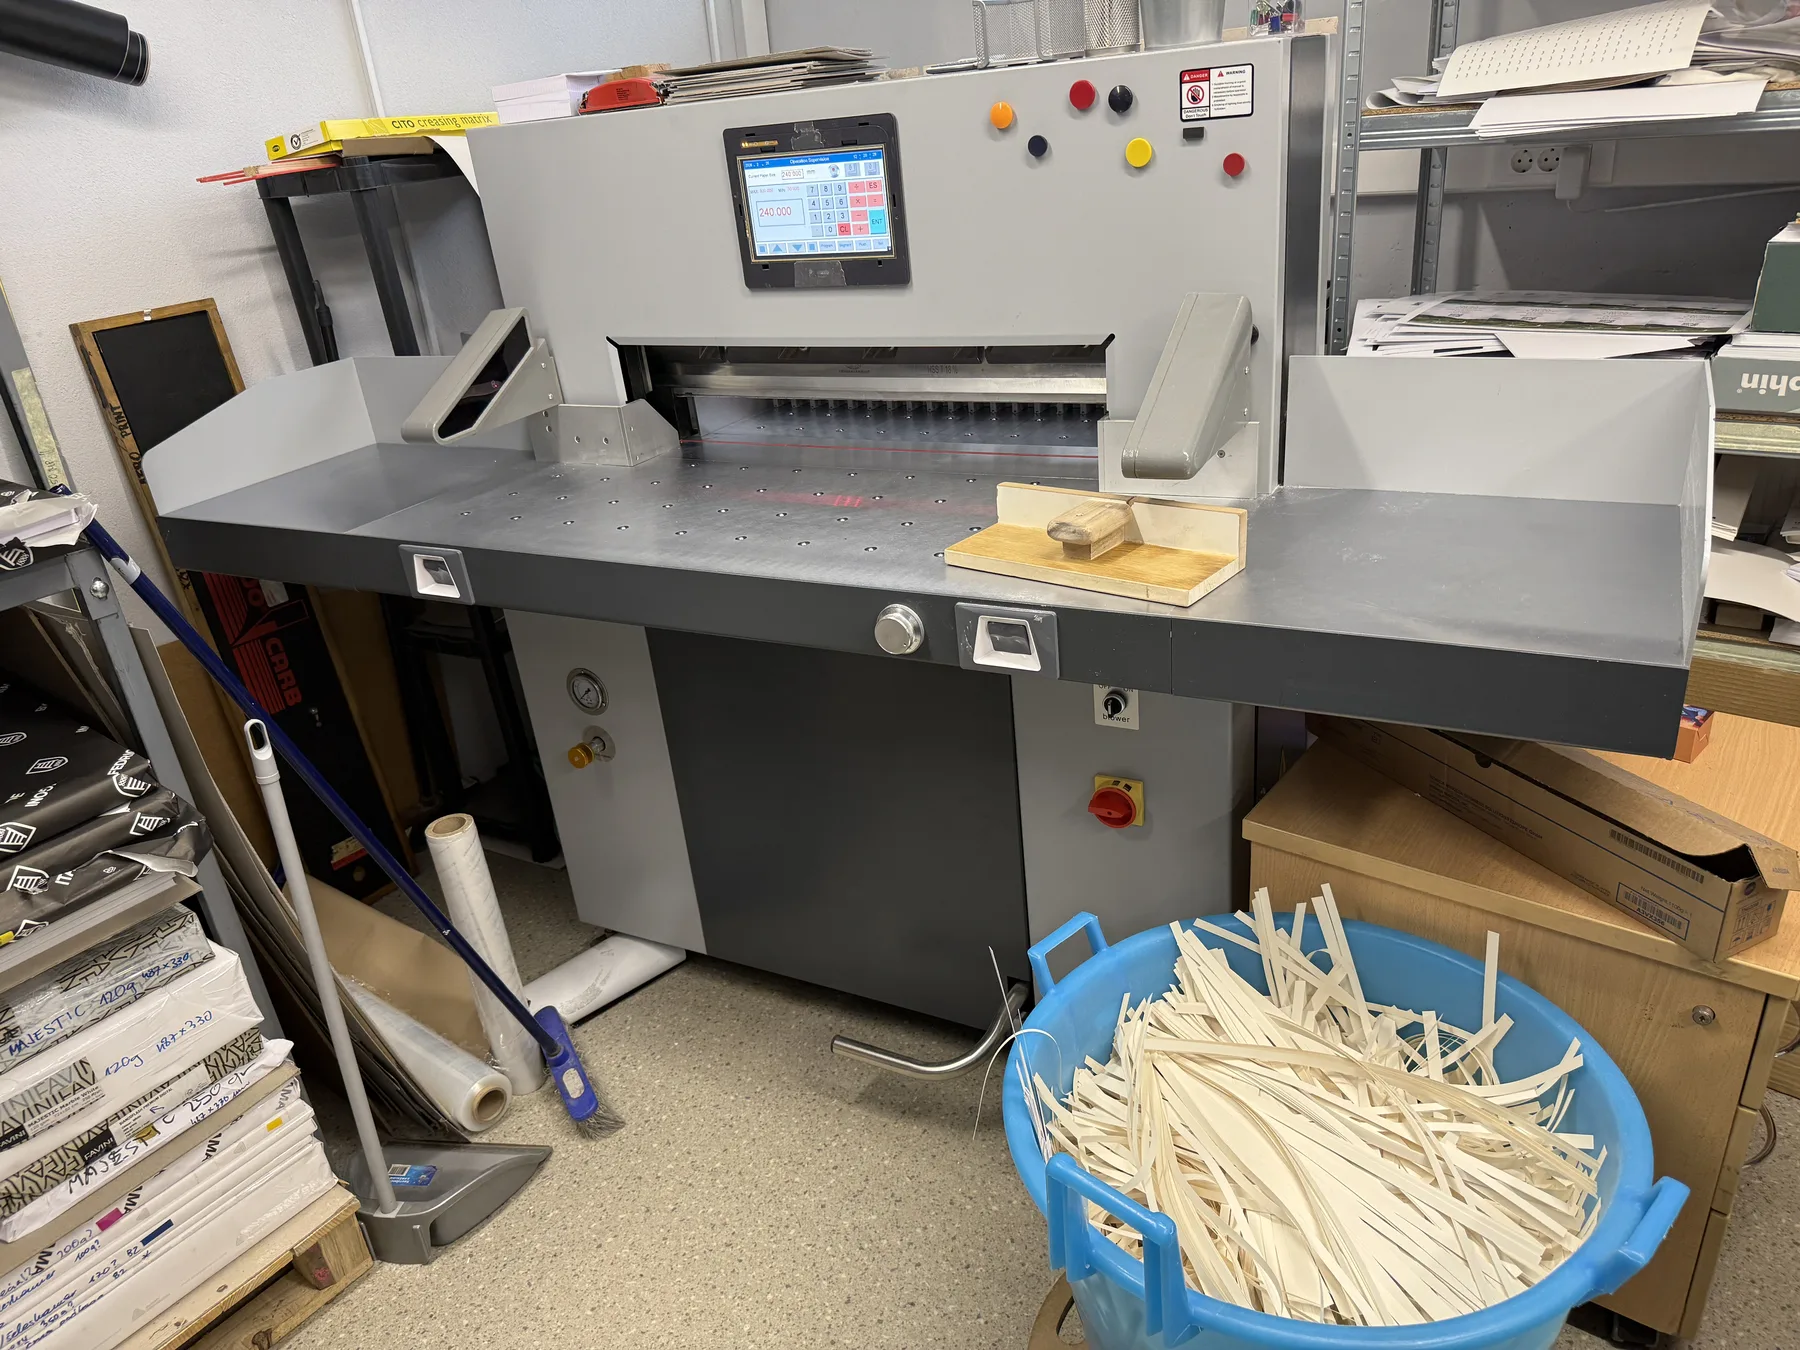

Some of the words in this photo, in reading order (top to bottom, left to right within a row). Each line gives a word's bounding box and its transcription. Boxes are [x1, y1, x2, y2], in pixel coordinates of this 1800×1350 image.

[391, 119, 415, 129] CITO
[417, 116, 459, 128] creasing
[461, 113, 492, 125] matrix
[760, 206, 792, 217] 240.000
[109, 403, 132, 438] PRINT
[265, 637, 302, 707] CARB
[9, 1003, 87, 1056] MAJESTIC
[99, 981, 138, 1005] 120g
[105, 1054, 144, 1076] 120g
[28, 1108, 59, 1127] MAJESTIC
[80, 1086, 99, 1098] White
[183, 1082, 221, 1112] 250
[0, 1129, 26, 1148] AVINI
[84, 1137, 113, 1160] FAVINI
